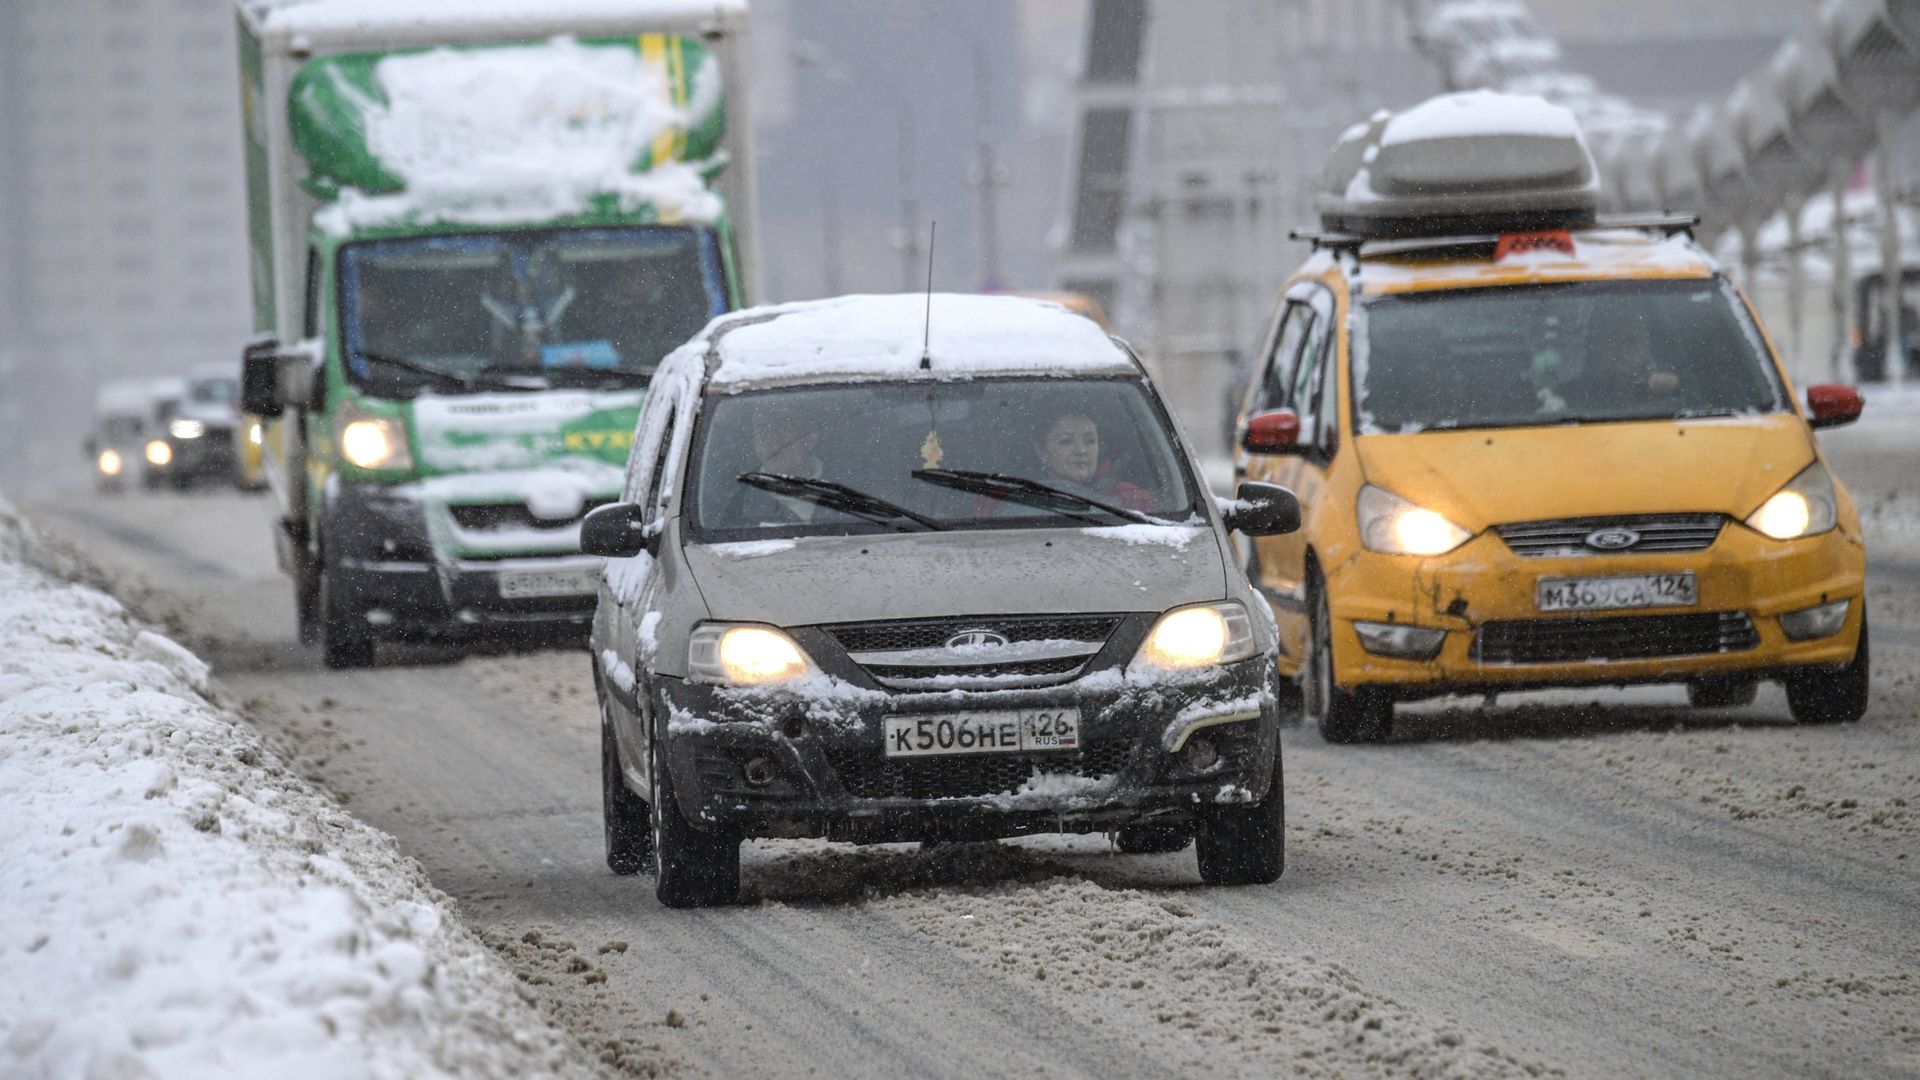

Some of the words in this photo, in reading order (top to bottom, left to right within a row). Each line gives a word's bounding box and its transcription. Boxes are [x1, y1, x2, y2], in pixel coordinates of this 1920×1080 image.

[1651, 576, 1691, 596] 124
[896, 718, 1016, 751] К506НЕ
[1023, 712, 1069, 737] 126
[1035, 736, 1058, 745] RUS
